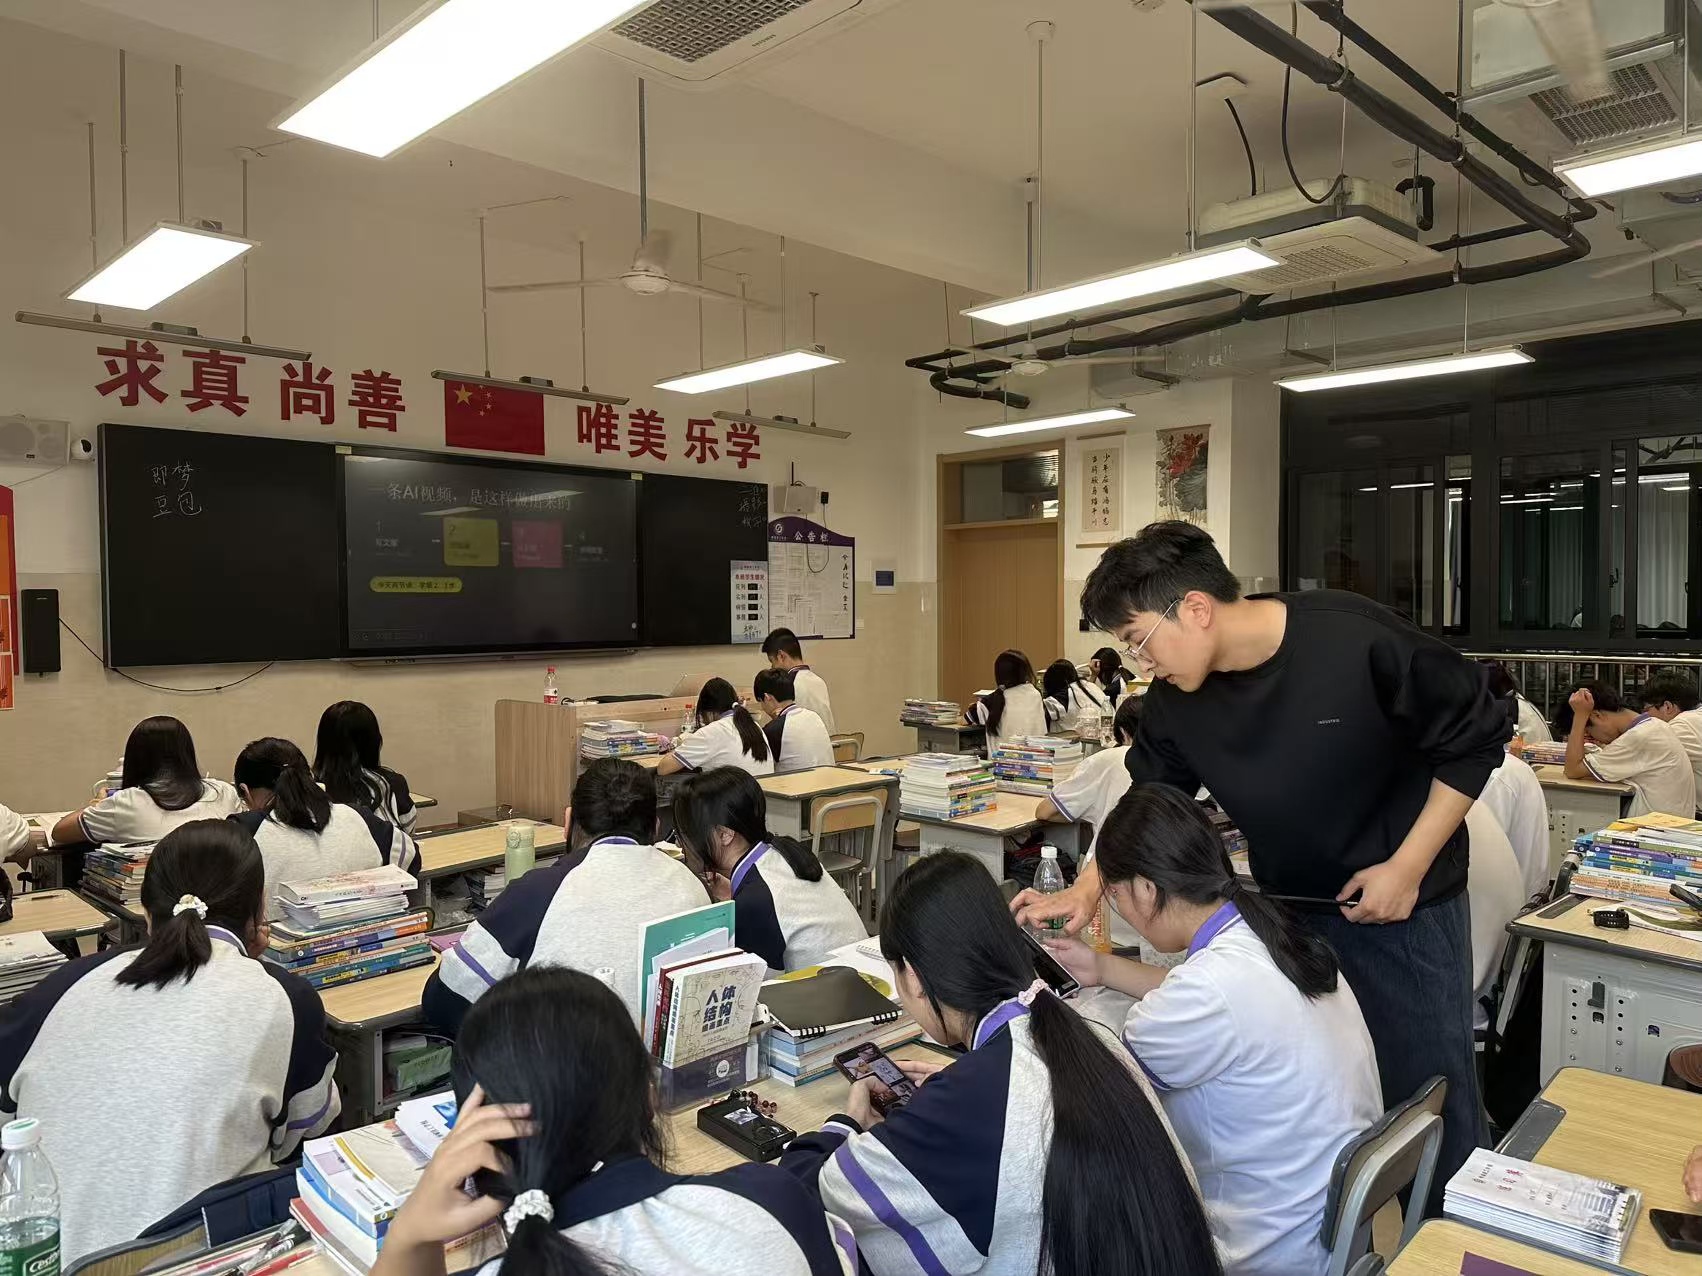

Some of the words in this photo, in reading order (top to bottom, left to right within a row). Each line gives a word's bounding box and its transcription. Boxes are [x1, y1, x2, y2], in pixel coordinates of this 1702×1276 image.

[153, 491, 202, 518] 豆包
[794, 530, 830, 543] 公告栏
[706, 985, 737, 1006] 人体
[703, 1001, 733, 1023] 结构
